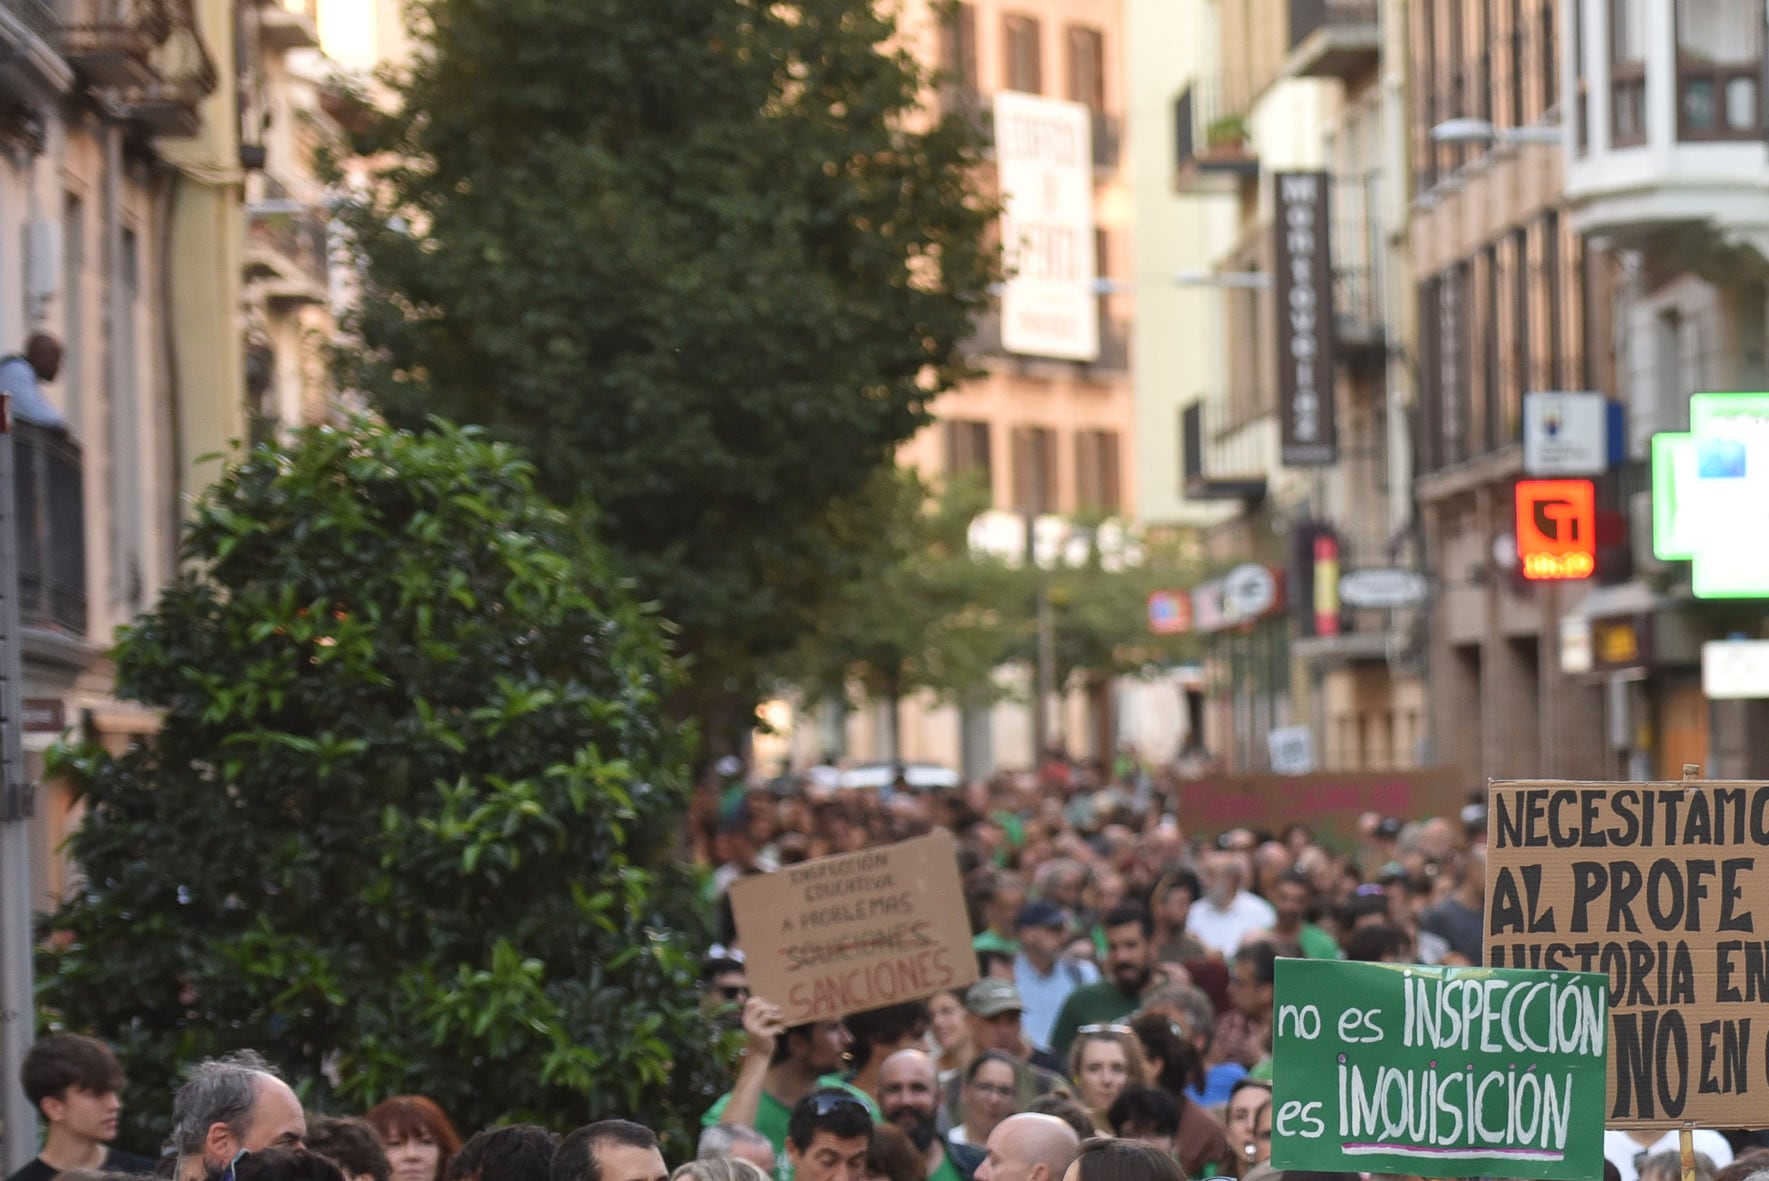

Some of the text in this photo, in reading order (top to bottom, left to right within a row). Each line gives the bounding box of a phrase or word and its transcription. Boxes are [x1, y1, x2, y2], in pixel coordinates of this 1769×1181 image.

[781, 890, 913, 934] A PROBLEMAS
[1490, 864, 1557, 936] AL
[1570, 857, 1756, 934] PROFE
[788, 947, 954, 1018] SANCIONES
[1278, 1004, 1322, 1040] no
[1337, 1007, 1385, 1043] es
[1611, 1008, 1689, 1119] NO
[1697, 1017, 1752, 1095] EN
[1276, 1100, 1325, 1139] es
